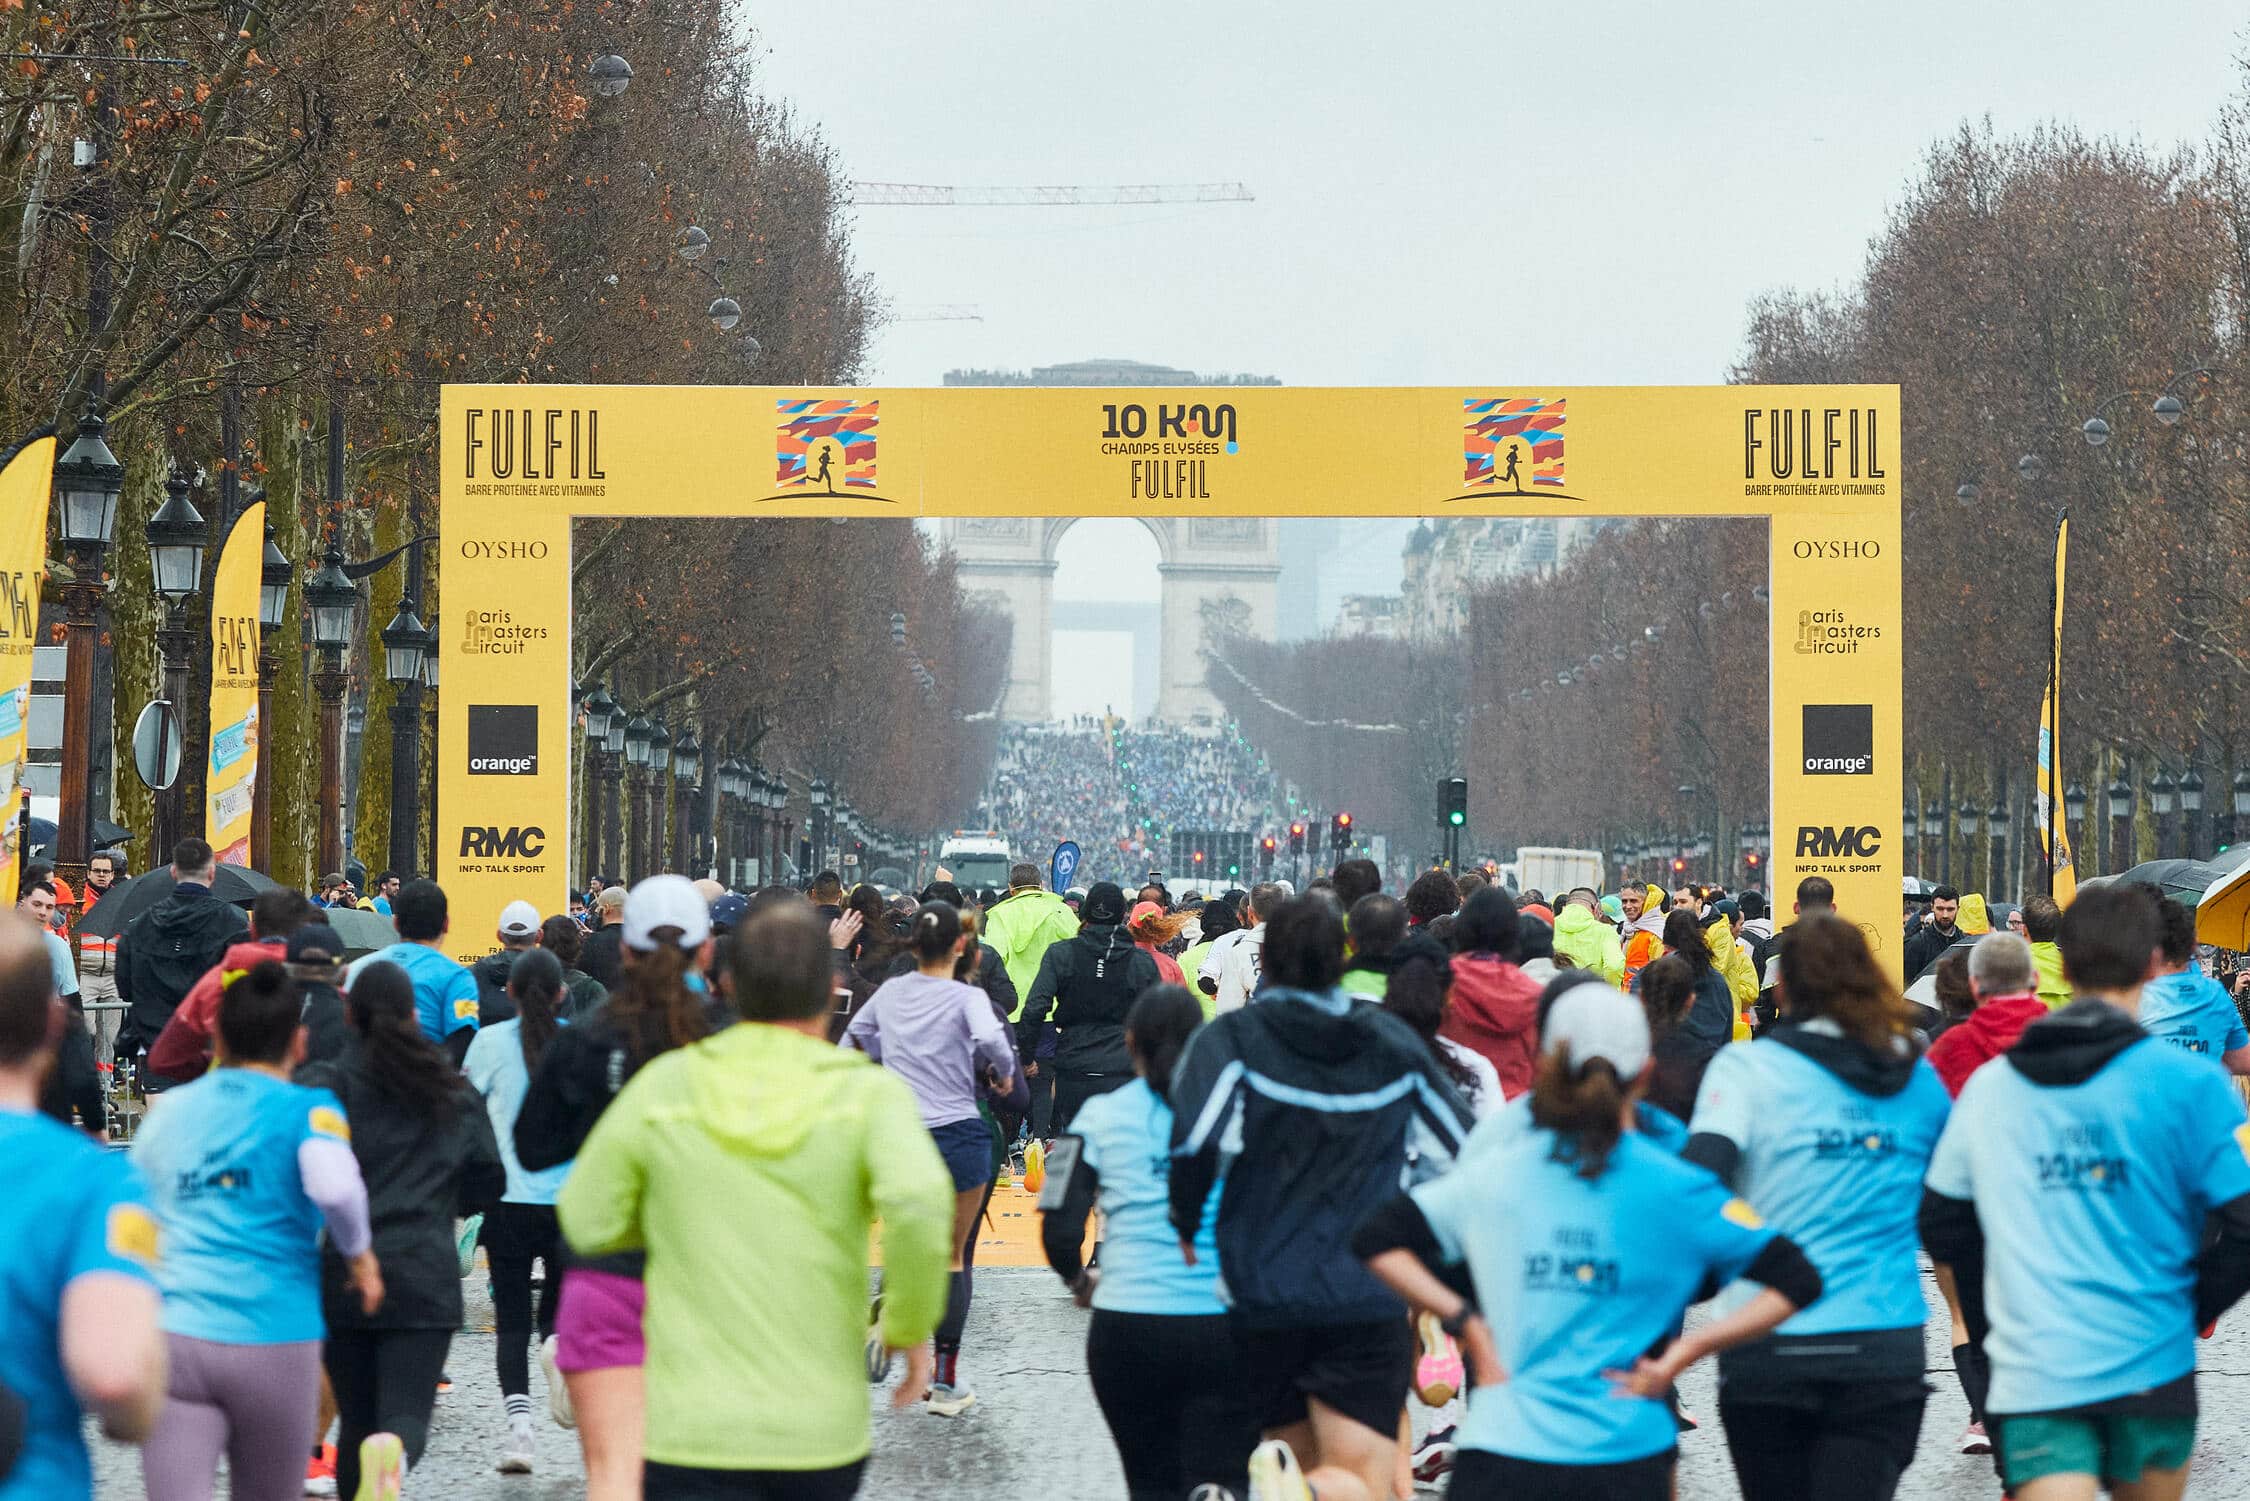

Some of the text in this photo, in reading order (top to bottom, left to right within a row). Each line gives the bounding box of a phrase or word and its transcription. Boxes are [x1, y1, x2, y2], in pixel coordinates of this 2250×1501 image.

[1102, 404, 1147, 438] 10
[466, 409, 606, 480] FULFIL
[1101, 440, 1220, 455] CHAMPS ELYSÉES
[1745, 409, 1885, 479] FULFIL
[1131, 460, 1210, 498] FULFIL
[465, 484, 492, 496] BARRE
[539, 484, 560, 497] AVEC
[561, 484, 606, 497] VITAMINES
[1745, 484, 1772, 497] BARRE
[1819, 484, 1840, 496] AVEC
[1841, 484, 1886, 496] VITAMINES
[461, 541, 548, 560] OYSHO
[1793, 541, 1880, 559] OYSHO
[459, 826, 546, 858] RMC
[1795, 826, 1882, 858] RMC
[459, 865, 546, 873] INFO TALK SPORT
[1795, 865, 1882, 873] INFO TALK SPORT
